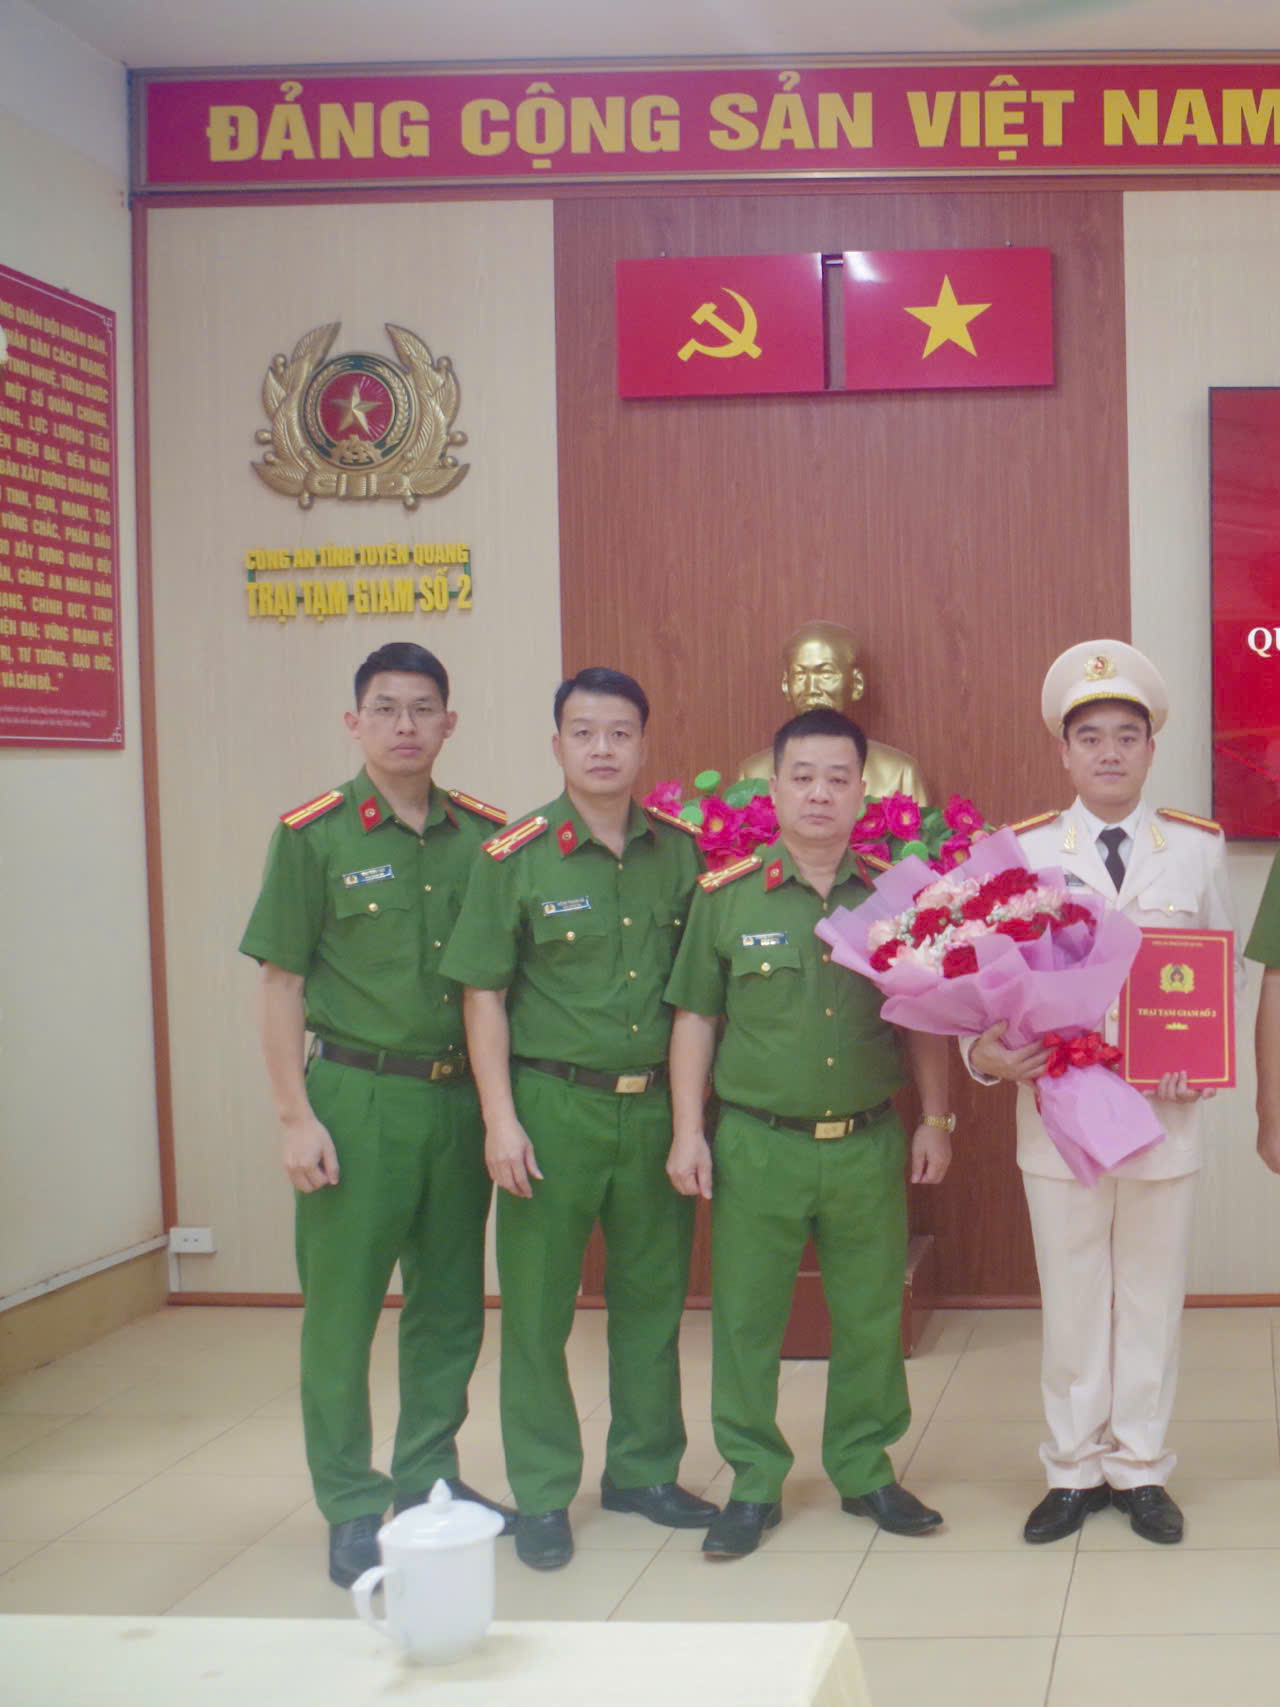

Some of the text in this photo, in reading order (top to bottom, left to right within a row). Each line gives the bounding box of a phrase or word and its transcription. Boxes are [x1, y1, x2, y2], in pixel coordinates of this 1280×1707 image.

[206, 81, 429, 162] ĐẢNG
[461, 81, 681, 169] CỘNG
[709, 71, 873, 152] SẢN
[906, 75, 1075, 161] VIỆT
[412, 543, 469, 567] QUANG
[246, 567, 473, 623] TRẠI TẠM GIAM SỐ 2
